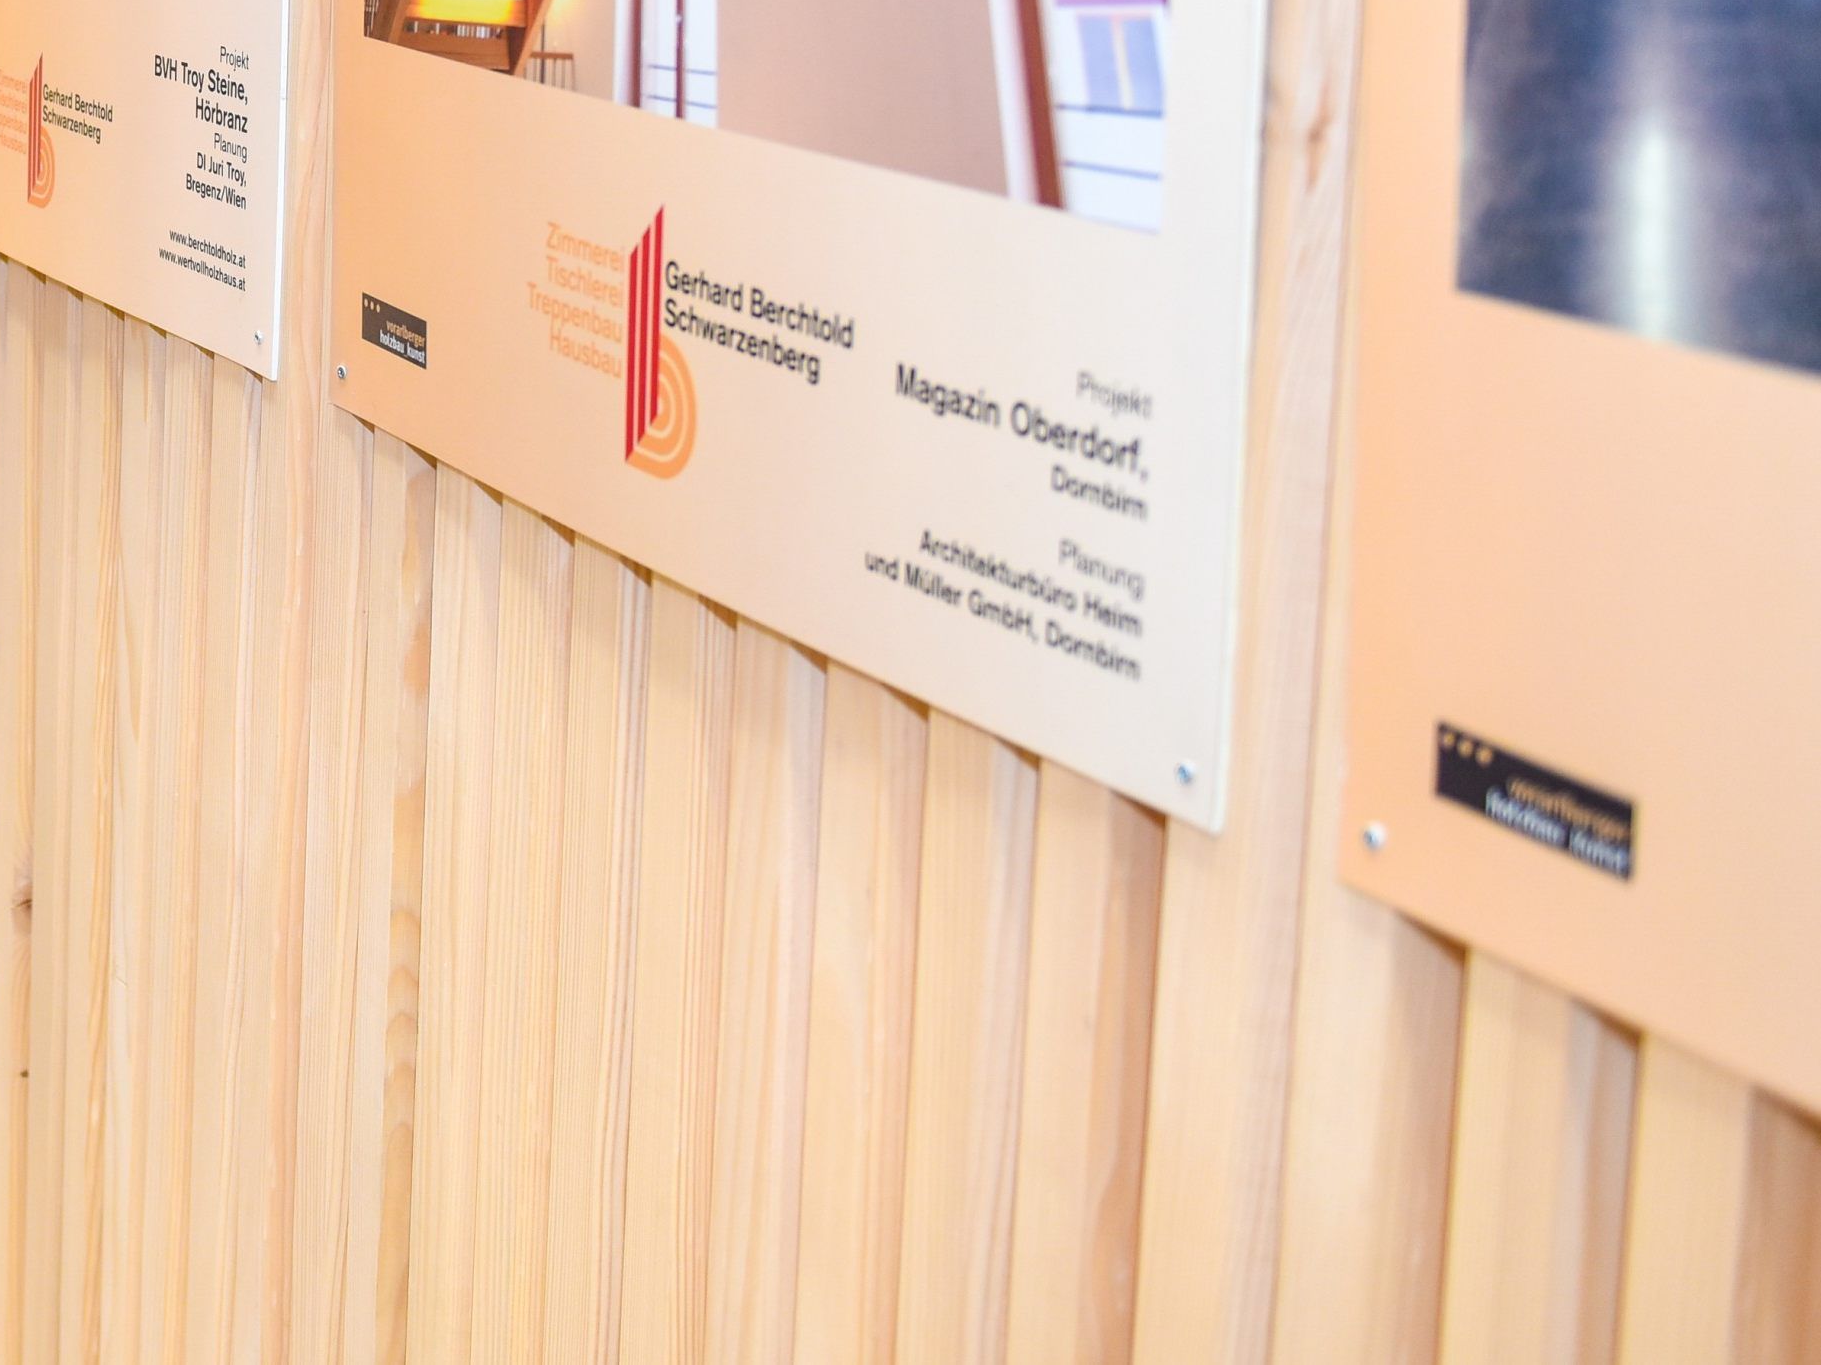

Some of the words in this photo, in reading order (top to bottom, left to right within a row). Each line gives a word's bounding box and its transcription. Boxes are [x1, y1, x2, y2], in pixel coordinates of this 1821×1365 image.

[154, 54, 178, 81] BVH
[181, 61, 205, 93] Troy
[207, 69, 248, 105] Steine,
[220, 45, 249, 71] Projekt
[42, 83, 73, 109] Gerhard
[74, 93, 114, 122] Berchtold
[42, 105, 101, 145] Schwarzenberg
[195, 96, 248, 133] Hörbranz
[197, 152, 206, 170] DI
[208, 156, 224, 177] Juri
[226, 161, 247, 187] Troy,
[214, 132, 248, 164] Planung
[186, 173, 247, 210] Bregenz/Wien
[159, 247, 246, 291] www.wertvollholzhaus.at
[169, 229, 246, 269] www.berchtoldholz.at
[546, 221, 625, 272] Zimmerei
[546, 255, 624, 308] Tischlerei
[665, 261, 744, 312] Gerhard
[750, 287, 855, 349] Berchtold
[526, 281, 623, 344] Treppenbau
[549, 321, 622, 379] Hausbau
[664, 298, 821, 385] Schwarzenberg
[1077, 371, 1152, 420] Projekt
[895, 363, 1000, 427] Magazin
[1010, 399, 1149, 482] Oberdorf,
[1051, 464, 1149, 521] Dornbirn
[919, 529, 1078, 611] Architekturbüro
[1082, 591, 1143, 637] Heim
[1058, 537, 1145, 601] Planung
[864, 551, 899, 581] und
[903, 562, 963, 607] Müller
[967, 588, 1038, 643] GmbH,
[1044, 618, 1141, 681] Dornbirn
